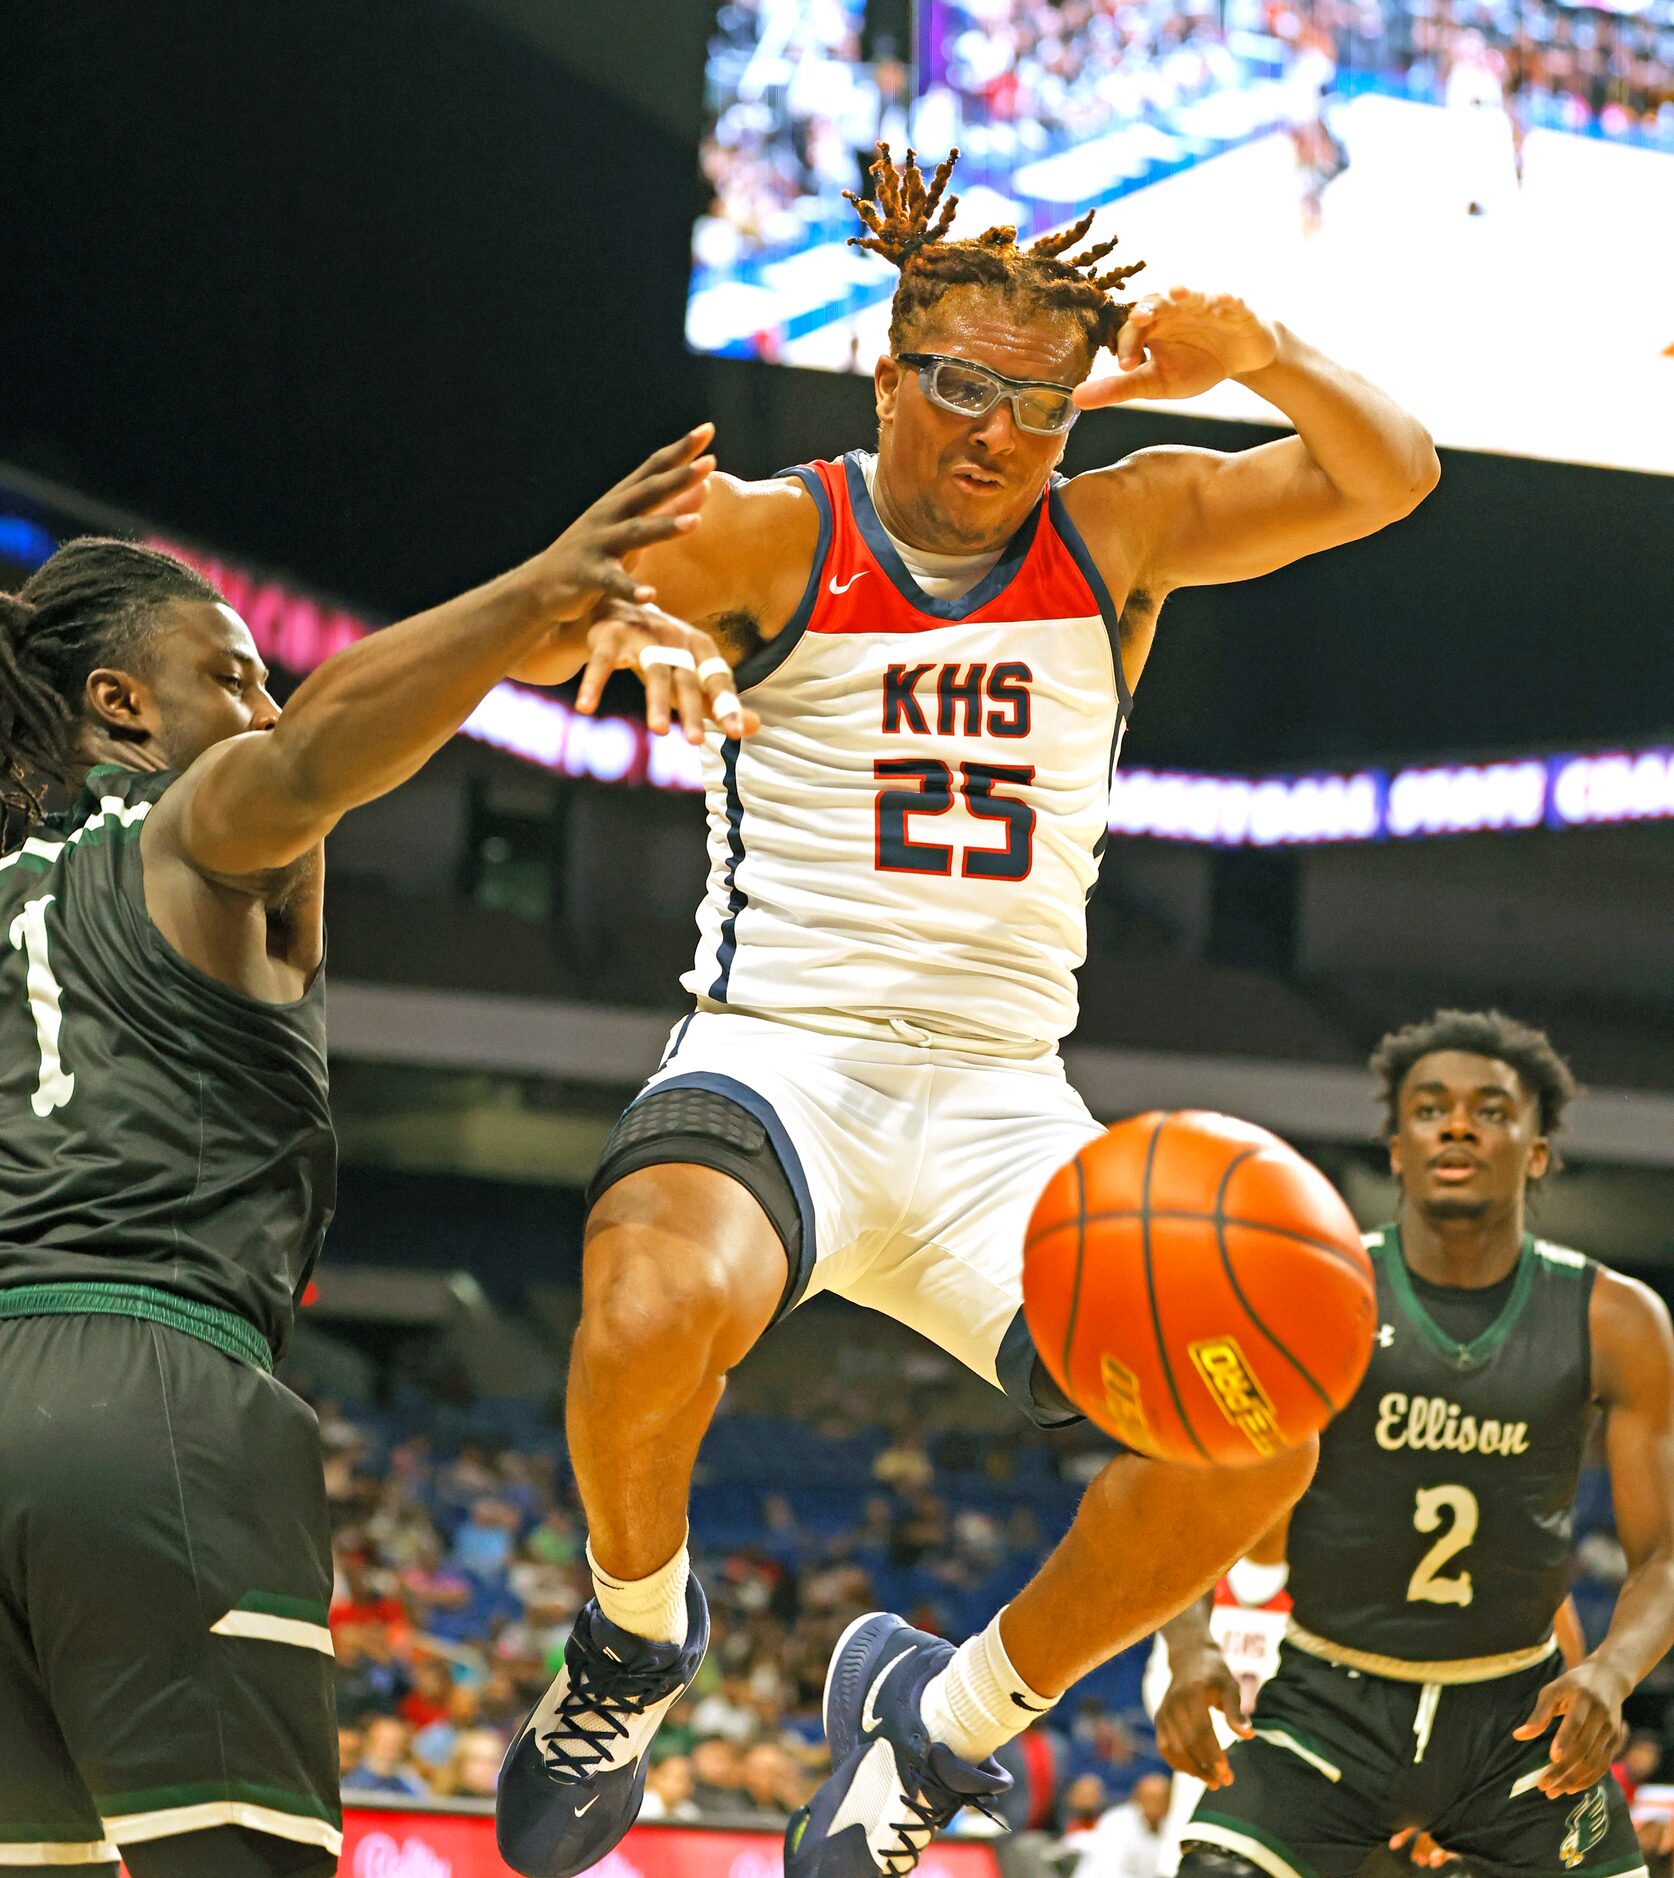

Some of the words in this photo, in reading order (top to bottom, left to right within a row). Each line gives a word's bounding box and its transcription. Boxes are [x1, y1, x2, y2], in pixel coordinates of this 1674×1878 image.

[882, 661, 1033, 738] KHS
[873, 758, 1036, 882] 25
[9, 894, 75, 1117] 1
[1375, 1392, 1530, 1456] Ellison
[1406, 1484, 1480, 1607] 2
